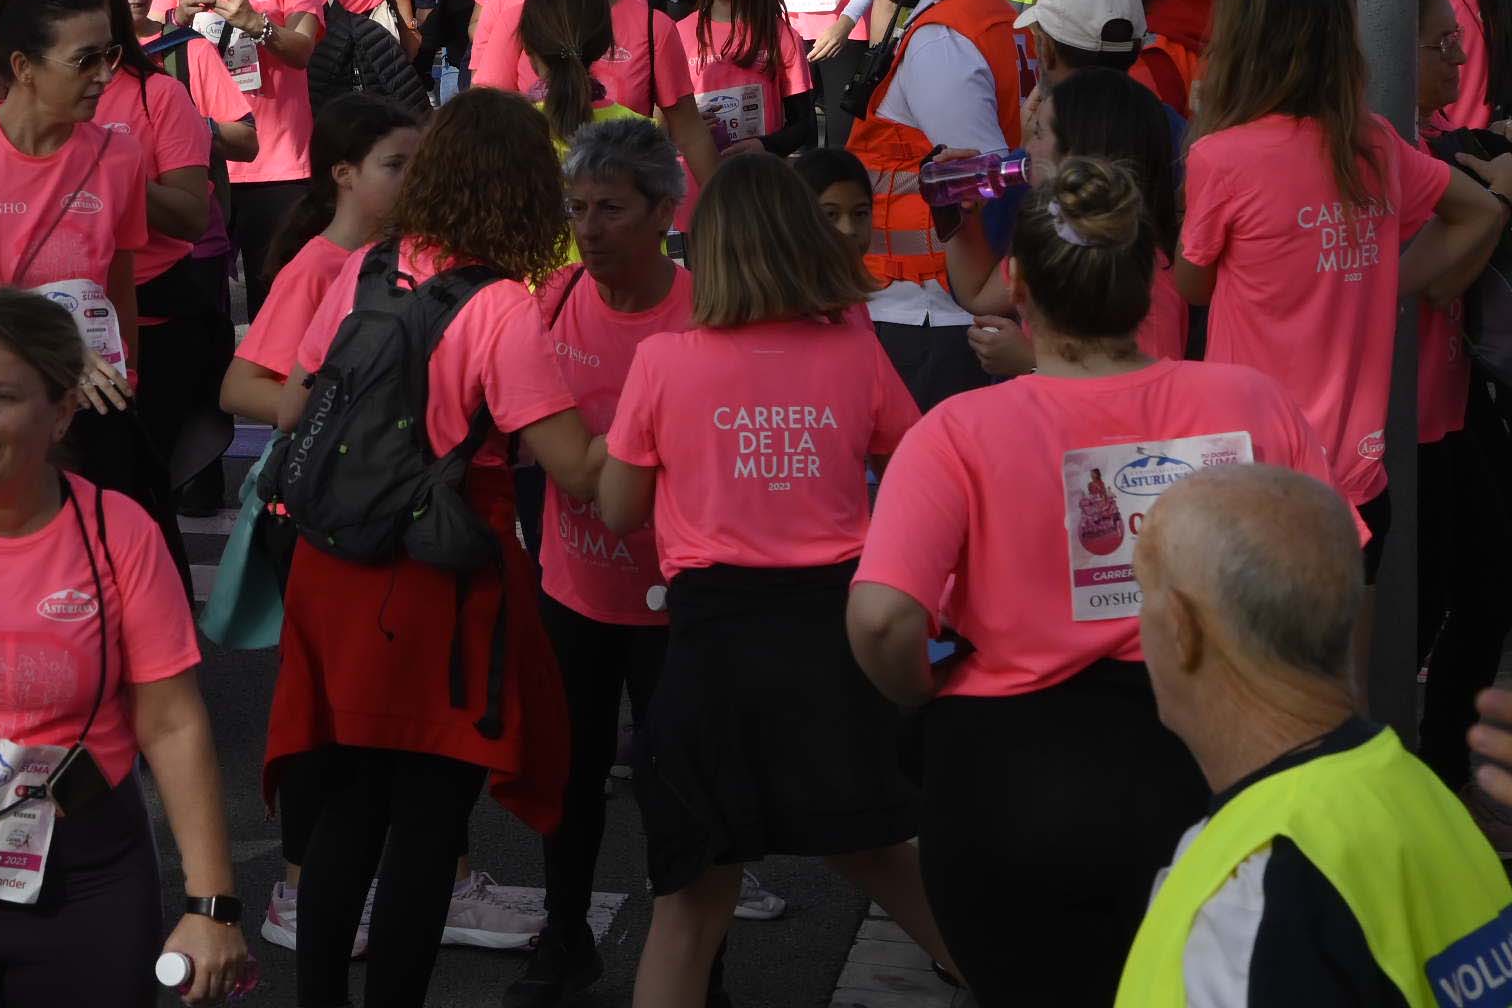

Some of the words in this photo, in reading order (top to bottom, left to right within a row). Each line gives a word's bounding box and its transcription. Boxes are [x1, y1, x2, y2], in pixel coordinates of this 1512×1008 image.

[1320, 227, 1348, 250] DE
[1355, 224, 1377, 244] LA
[1315, 245, 1381, 274] MUJER
[1344, 273, 1363, 282] 2023
[712, 406, 838, 430] CARRERA
[738, 430, 773, 454] DE
[782, 430, 817, 453] LA
[733, 454, 822, 479] MUJER
[767, 482, 791, 491] 2023
[41, 600, 96, 615] ASTURIANA
[19, 763, 50, 775] SUMA
[5, 854, 28, 866] 2023
